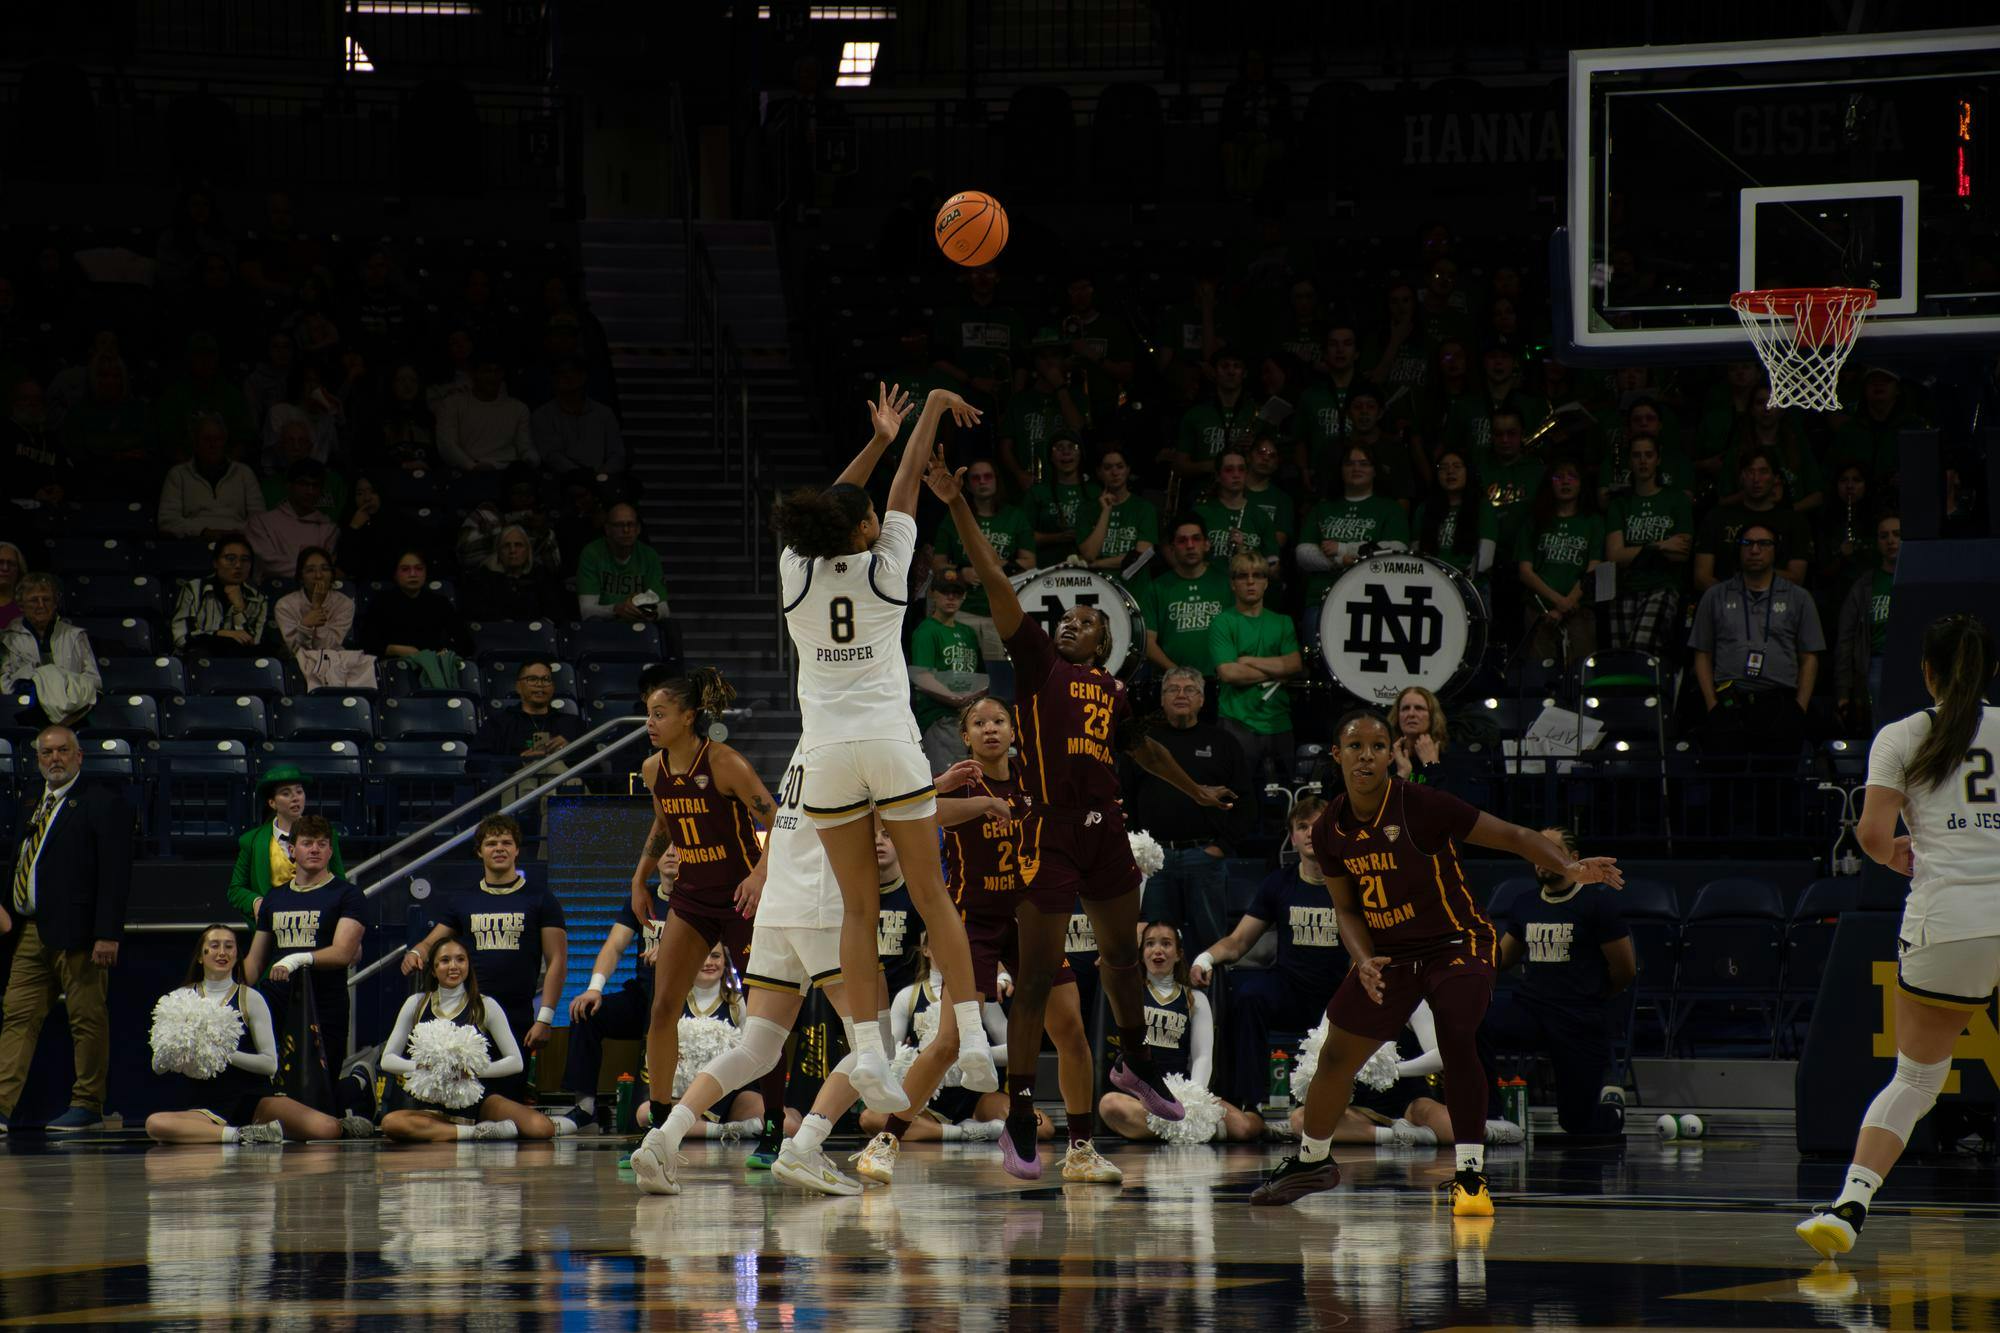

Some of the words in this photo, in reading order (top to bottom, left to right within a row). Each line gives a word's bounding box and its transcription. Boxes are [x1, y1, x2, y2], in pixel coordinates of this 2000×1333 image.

[1733, 100, 1904, 156] GISEA
[826, 139, 847, 161] 14
[1383, 562, 1425, 575] YAMAHA
[1055, 576, 1093, 588] YAMAHA
[829, 596, 855, 643] 8
[816, 645, 874, 662] PROSPER
[1083, 703, 1111, 741] 23
[1965, 749, 1999, 805] 2
[661, 797, 711, 815] CENTRAL
[678, 816, 701, 847] 11
[1947, 812, 1968, 830] de
[997, 841, 1014, 873] 2
[1359, 875, 1389, 909] 21
[272, 910, 320, 931] NOTRE
[470, 912, 526, 933] NOTRE
[275, 928, 317, 949] DAME
[474, 931, 521, 951] DAME
[1292, 925, 1340, 947] DAME
[1525, 922, 1575, 943] NOTRE
[1528, 941, 1571, 963] DAME
